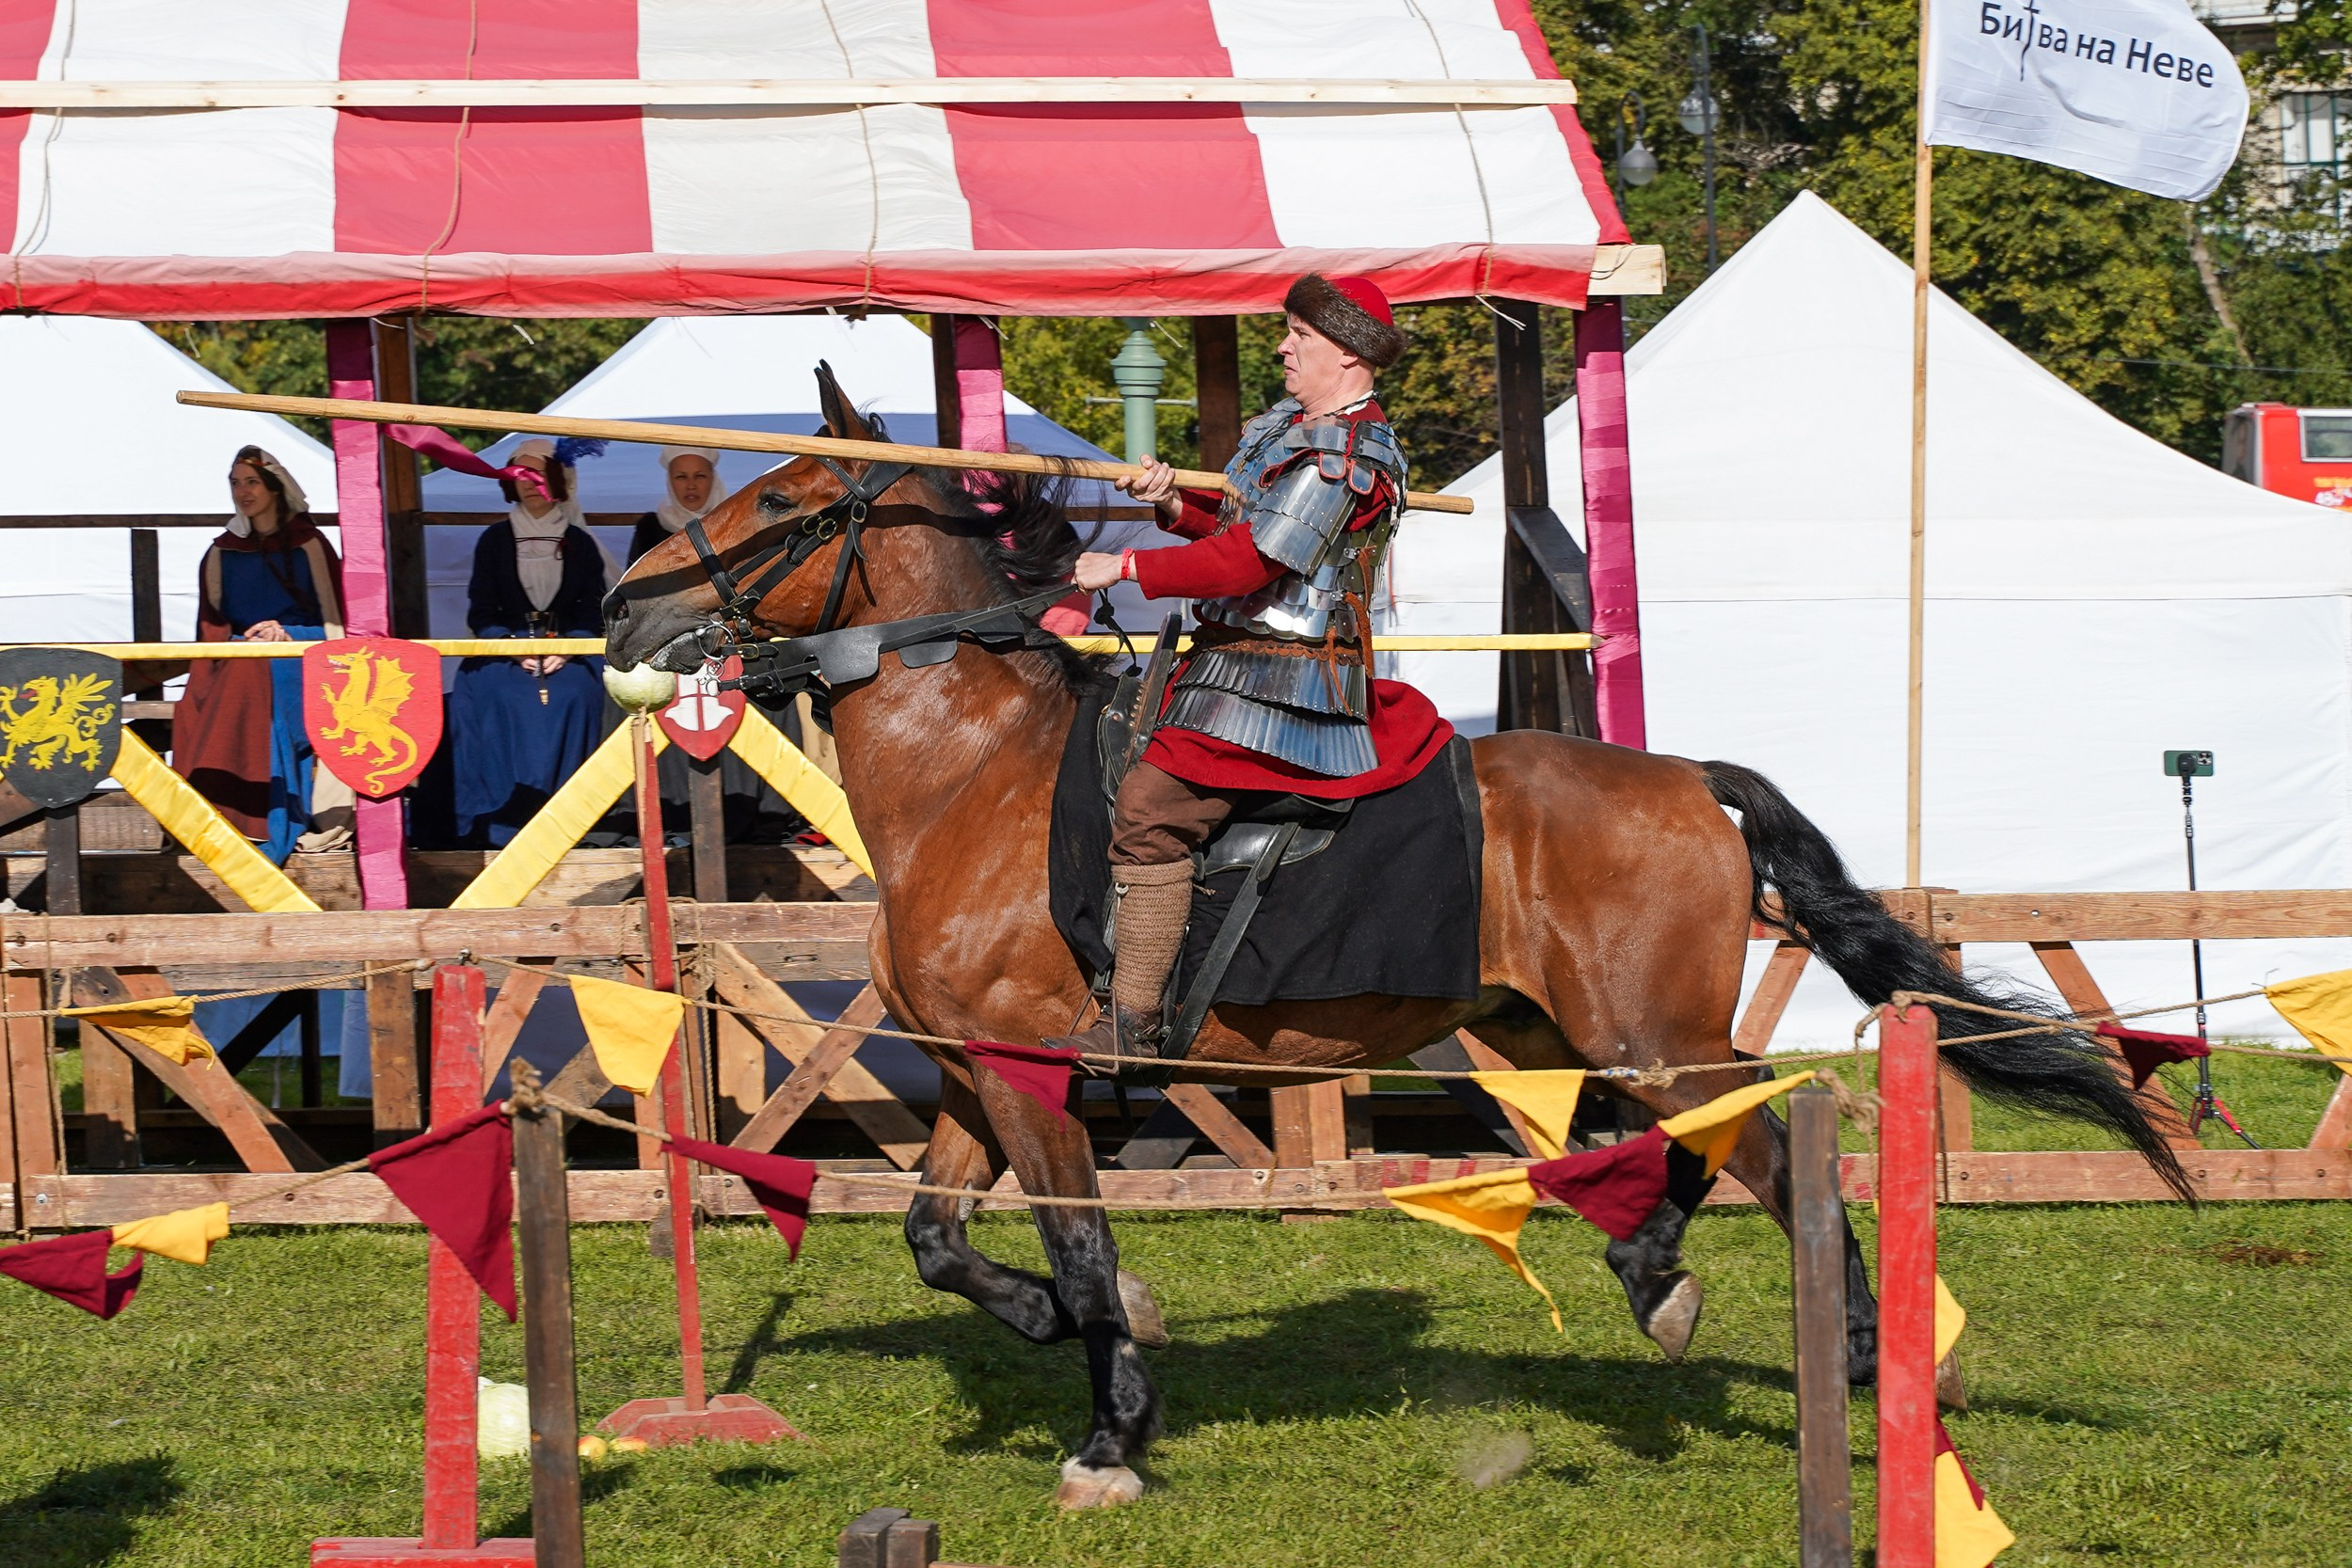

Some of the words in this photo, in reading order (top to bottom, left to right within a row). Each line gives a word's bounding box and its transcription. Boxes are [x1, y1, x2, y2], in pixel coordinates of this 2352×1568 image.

[1979, 0, 2069, 81] Битва
[2074, 34, 2115, 65] на
[2125, 38, 2214, 88] Неве
